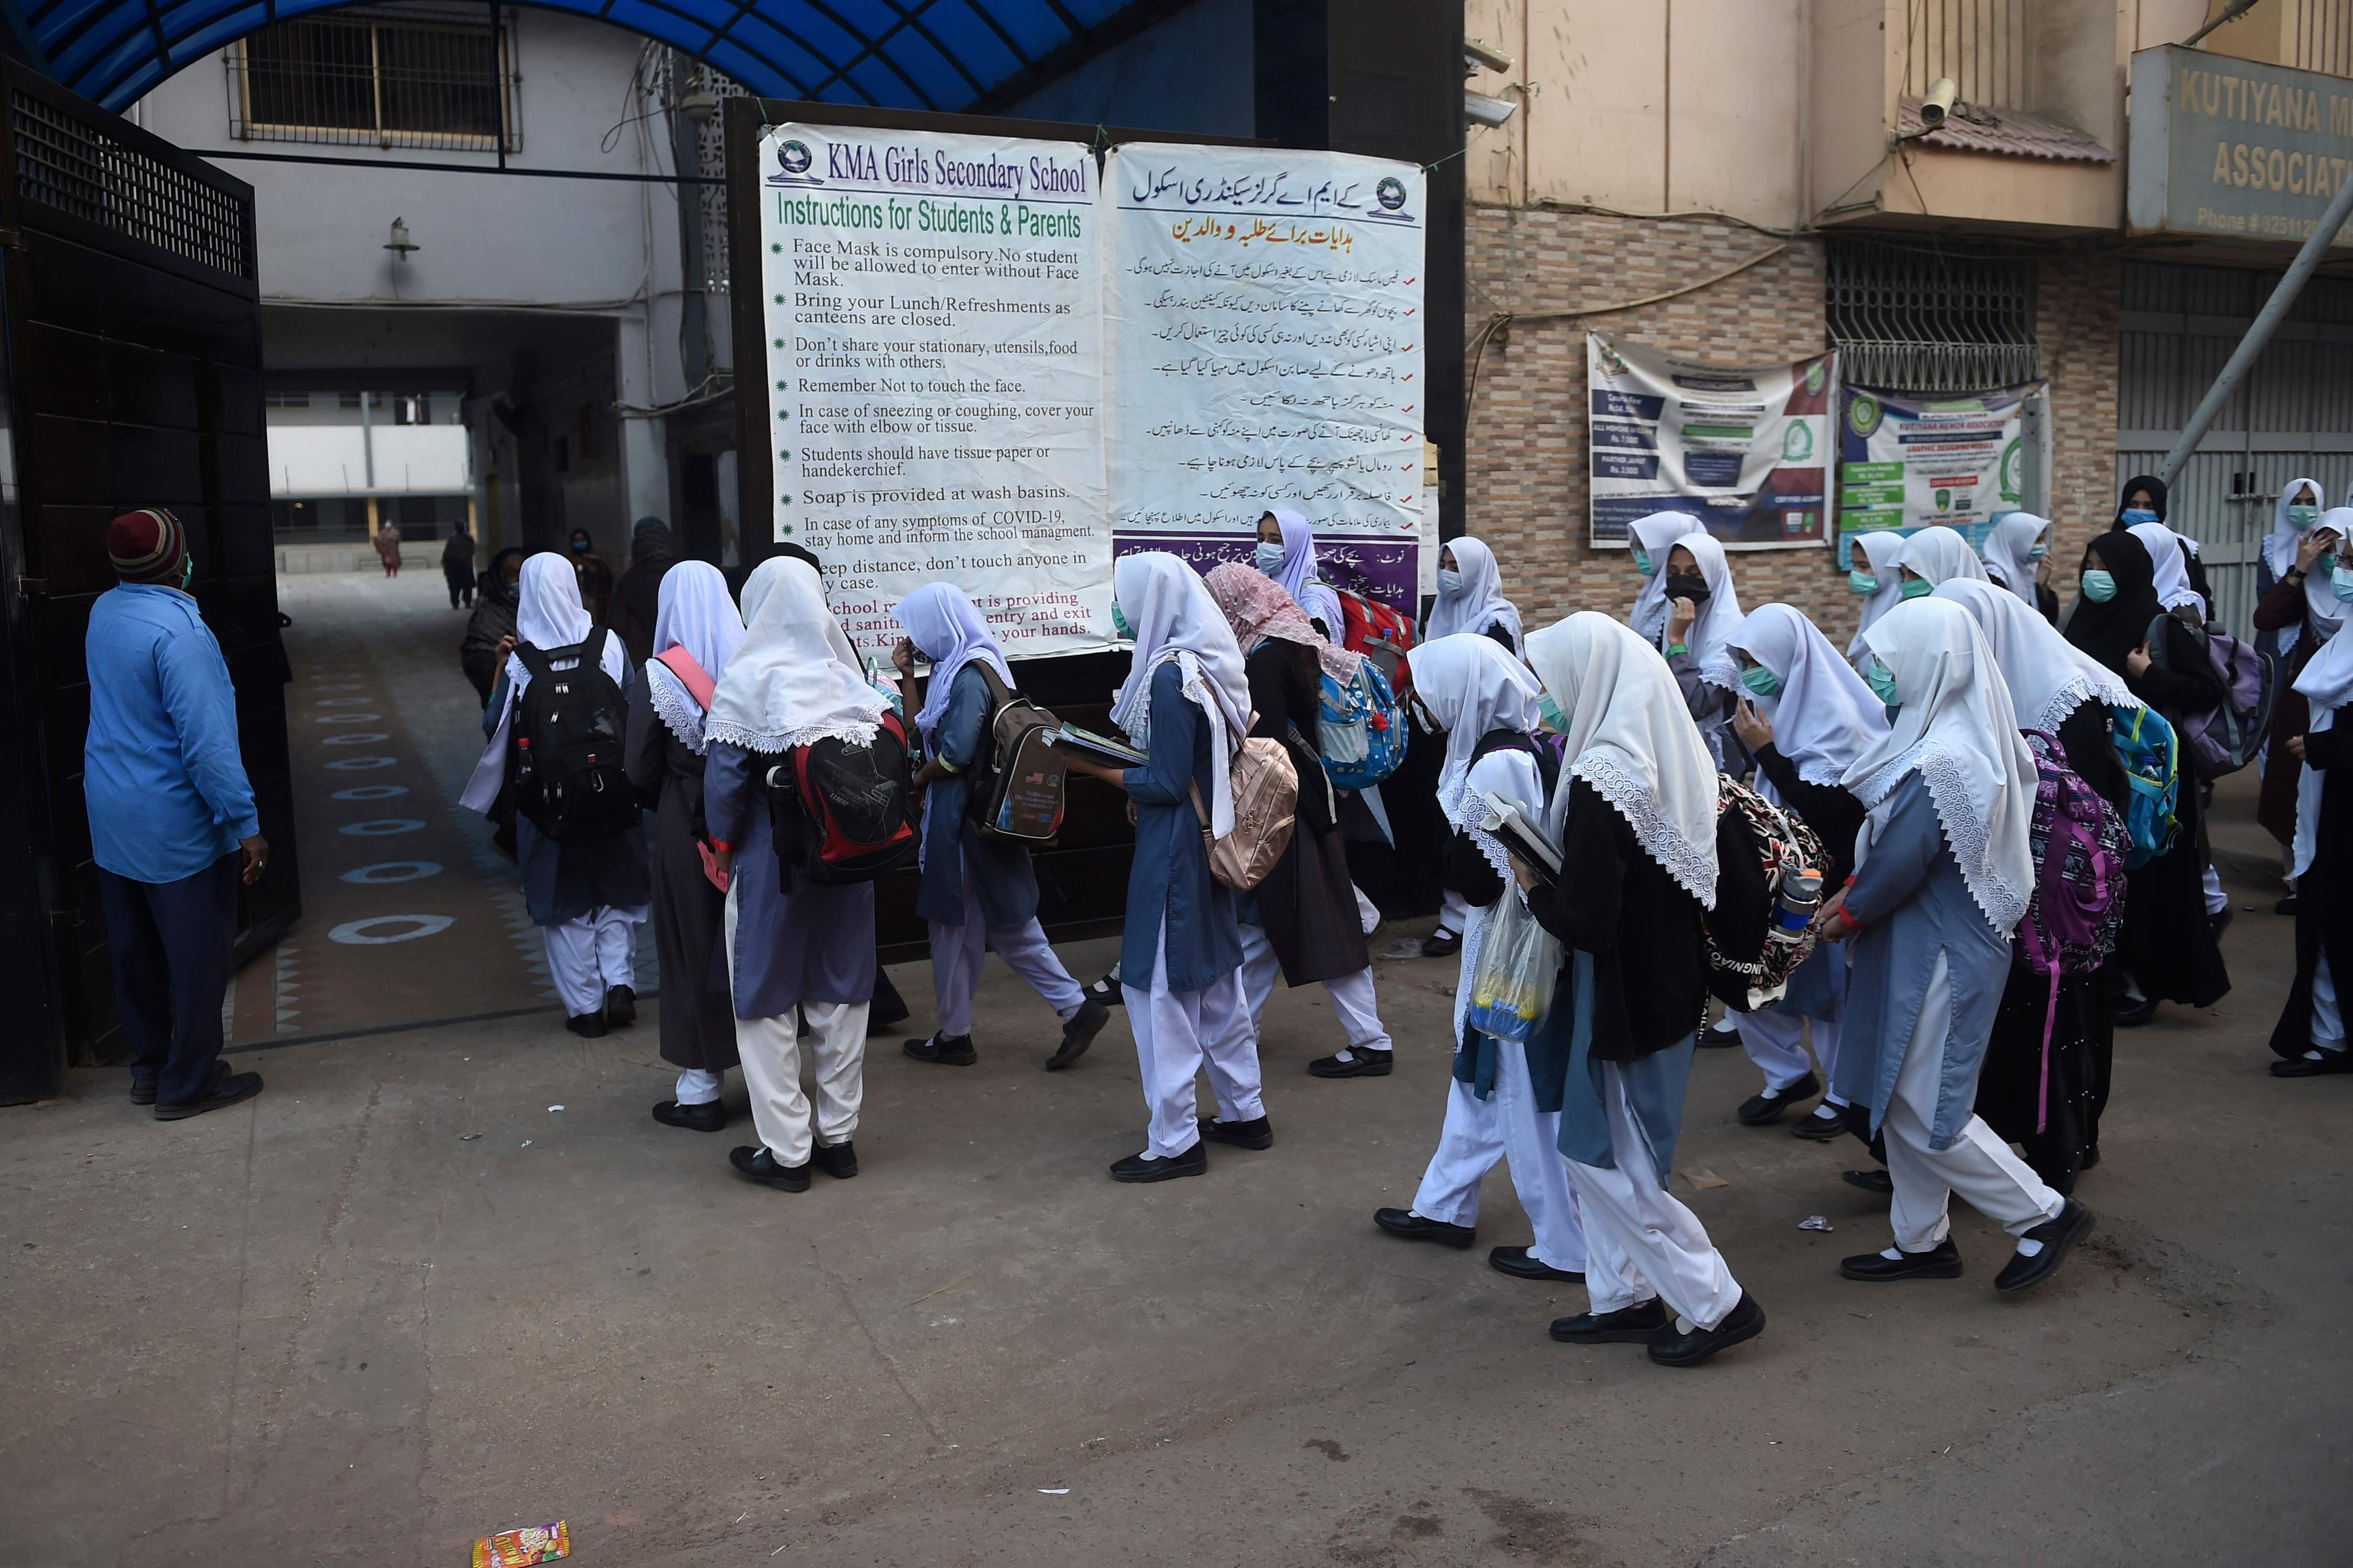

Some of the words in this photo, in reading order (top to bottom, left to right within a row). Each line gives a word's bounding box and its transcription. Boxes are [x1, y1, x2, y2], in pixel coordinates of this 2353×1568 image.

[2181, 68, 2321, 134] KUTIYANA
[829, 142, 879, 181] KMA
[886, 146, 929, 183] Girls
[935, 149, 1023, 199] Secondary
[1030, 156, 1084, 194] School
[778, 192, 883, 229] Instructions
[888, 198, 912, 230] for
[919, 200, 994, 234] Students
[1000, 204, 1011, 235] &
[1018, 205, 1081, 238] Parents
[2197, 207, 2245, 231] Phone
[1308, 225, 1353, 254] ہدایات
[793, 238, 831, 253] Face
[837, 240, 880, 256] Mask
[886, 243, 898, 257] is
[1026, 250, 1078, 264] student
[793, 257, 824, 269] will
[832, 258, 849, 270] be
[855, 259, 916, 273] allowed
[922, 262, 936, 274] to
[942, 264, 979, 276] enter
[984, 264, 1041, 278] without
[1047, 266, 1079, 279] Face
[794, 271, 843, 287] Mask.
[795, 292, 842, 311] Bring
[847, 298, 884, 311] your
[890, 295, 1050, 313] Lunch/Refreshments
[1055, 304, 1070, 314] as
[795, 311, 866, 324] canteens
[872, 315, 895, 325] are
[901, 312, 955, 326] closed.
[796, 337, 837, 352] Don't
[843, 337, 878, 351] share
[883, 343, 915, 357] your
[920, 339, 989, 356] stationary,
[796, 357, 811, 367] or
[816, 353, 860, 367] drinks
[865, 354, 895, 368] with
[900, 354, 945, 368] others.
[799, 378, 876, 392] Remember
[880, 378, 906, 392] Not
[910, 380, 923, 392] to
[928, 379, 965, 392] touch
[970, 379, 989, 392] the
[995, 379, 1025, 392] face.
[800, 404, 813, 417] In
[819, 408, 849, 417] case
[854, 403, 868, 417] of
[874, 403, 933, 421] sneezing
[937, 407, 951, 417] or
[956, 403, 1020, 420] coughing,
[1026, 407, 1061, 416] cover
[1065, 407, 1094, 420] your
[800, 420, 829, 433] face
[833, 419, 865, 433] with
[870, 419, 912, 433] elbow
[917, 423, 931, 432] or
[935, 419, 976, 432] tissue.
[801, 446, 863, 462] Students
[868, 446, 913, 460] should
[919, 446, 949, 459] have
[954, 446, 992, 459] tissue
[996, 448, 1032, 462] paper
[1036, 448, 1050, 457] or
[802, 462, 906, 477] handekerchief.
[802, 490, 846, 507] Soap
[852, 490, 865, 503] is
[872, 487, 945, 507] provided
[952, 488, 965, 500] at
[970, 486, 1012, 500] wash
[1018, 484, 1071, 499] basins.
[805, 518, 818, 531] In
[823, 520, 852, 530] case
[856, 515, 871, 529] of
[875, 519, 897, 531] any
[902, 515, 967, 530] symptoms
[972, 512, 985, 526] of
[994, 510, 1065, 524] COVID-19,
[805, 535, 832, 550] stay
[837, 532, 874, 545] home
[879, 530, 901, 544] and
[907, 529, 949, 543] inform
[954, 528, 973, 541] the
[977, 526, 1018, 540] school
[1021, 525, 1095, 541] managment.
[821, 564, 847, 577] eep
[853, 560, 920, 573] distance,
[927, 556, 966, 570] don't
[971, 554, 1012, 568] touch
[1018, 553, 1068, 568] anyone
[1073, 551, 1086, 563] in
[841, 579, 878, 592] case.
[988, 595, 1000, 607] is
[1006, 592, 1079, 610] providing
[986, 612, 1025, 625] entry
[1031, 608, 1058, 621] and
[1064, 607, 1091, 618] exit
[1001, 628, 1036, 642] your
[1041, 622, 1091, 636] hands.
